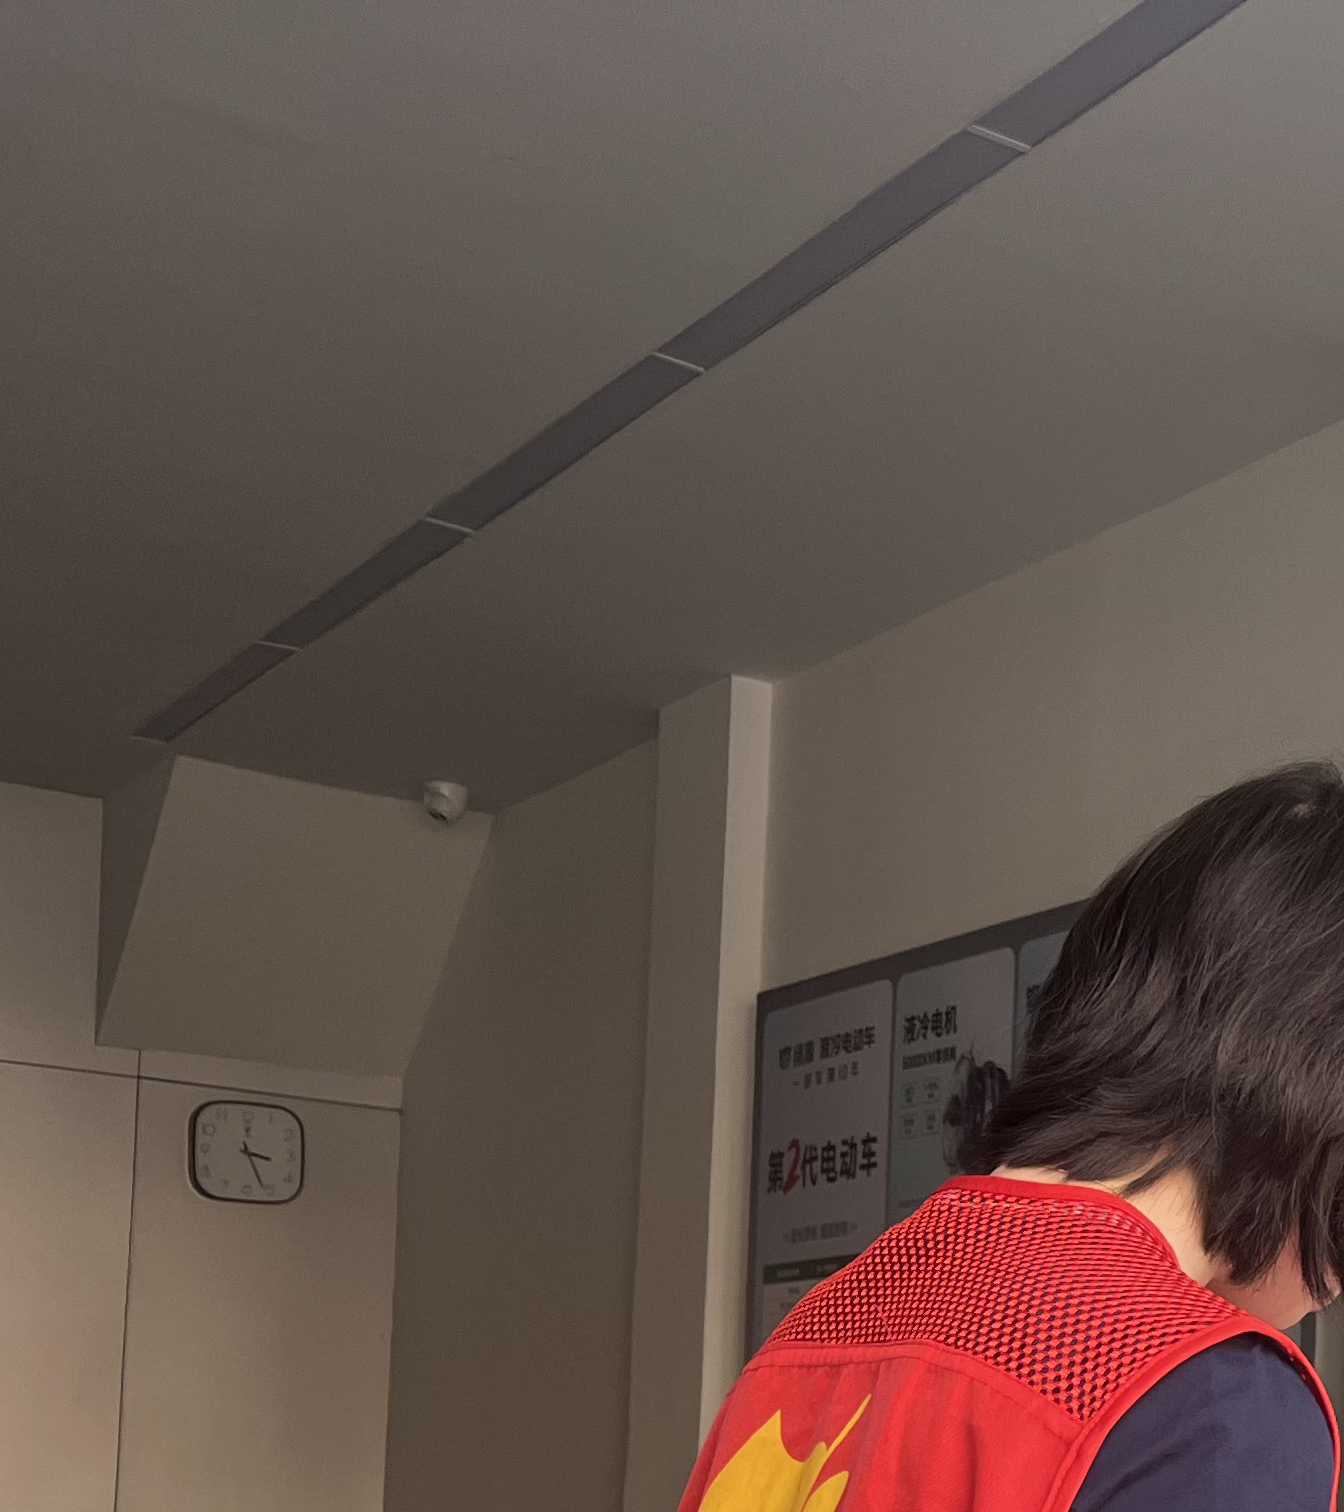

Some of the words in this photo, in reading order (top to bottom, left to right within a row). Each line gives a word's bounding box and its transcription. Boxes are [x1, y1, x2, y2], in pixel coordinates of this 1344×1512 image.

[766, 1132, 878, 1196] 第2代电动车
